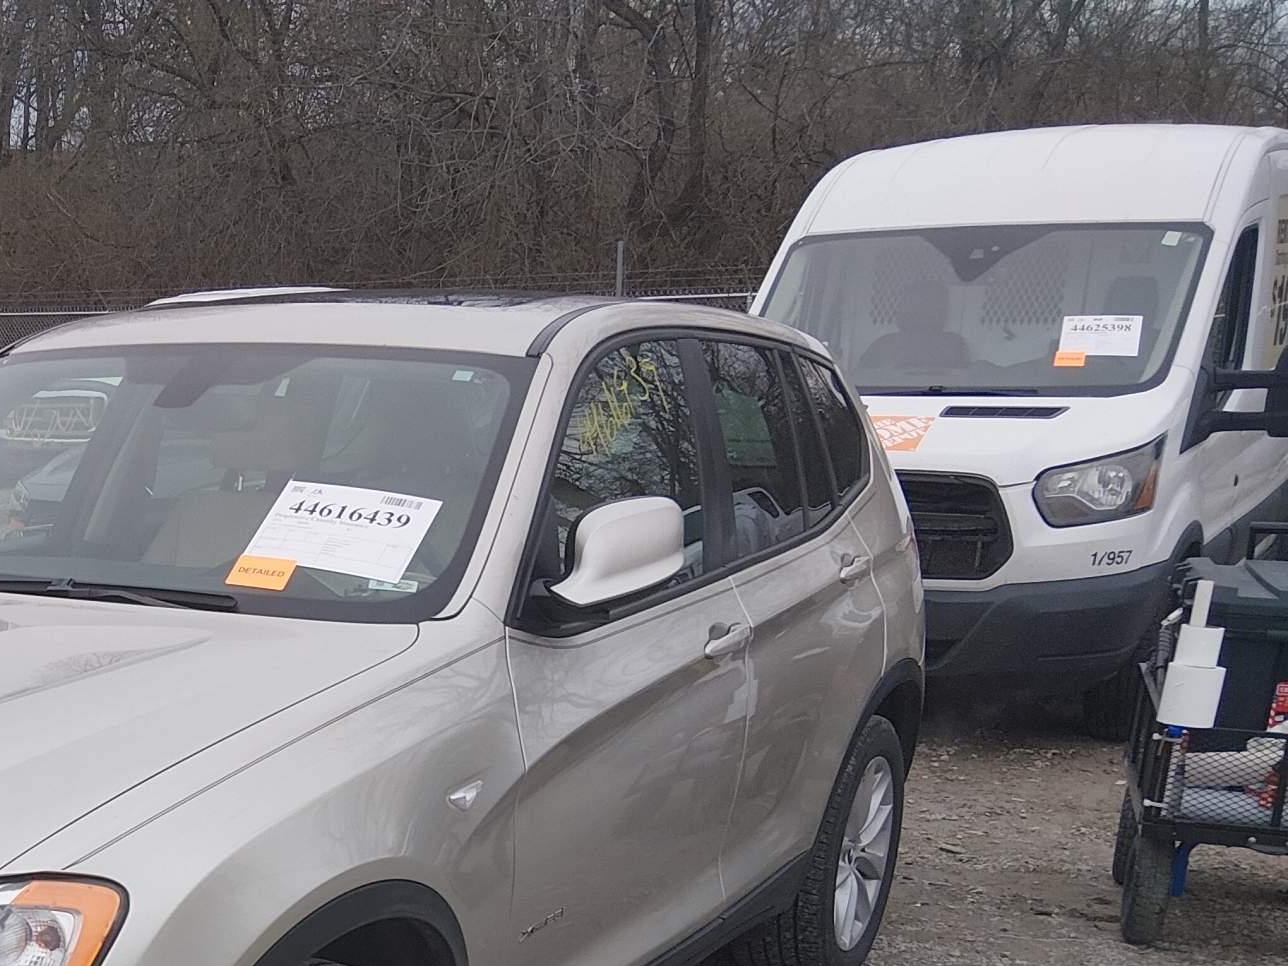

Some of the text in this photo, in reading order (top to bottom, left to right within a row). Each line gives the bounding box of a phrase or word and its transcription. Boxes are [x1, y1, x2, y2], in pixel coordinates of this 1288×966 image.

[1070, 323, 1132, 332] 44625398
[288, 499, 411, 529] 44616439
[1091, 549, 1133, 566] 1/957
[237, 565, 285, 578] DETAILED
